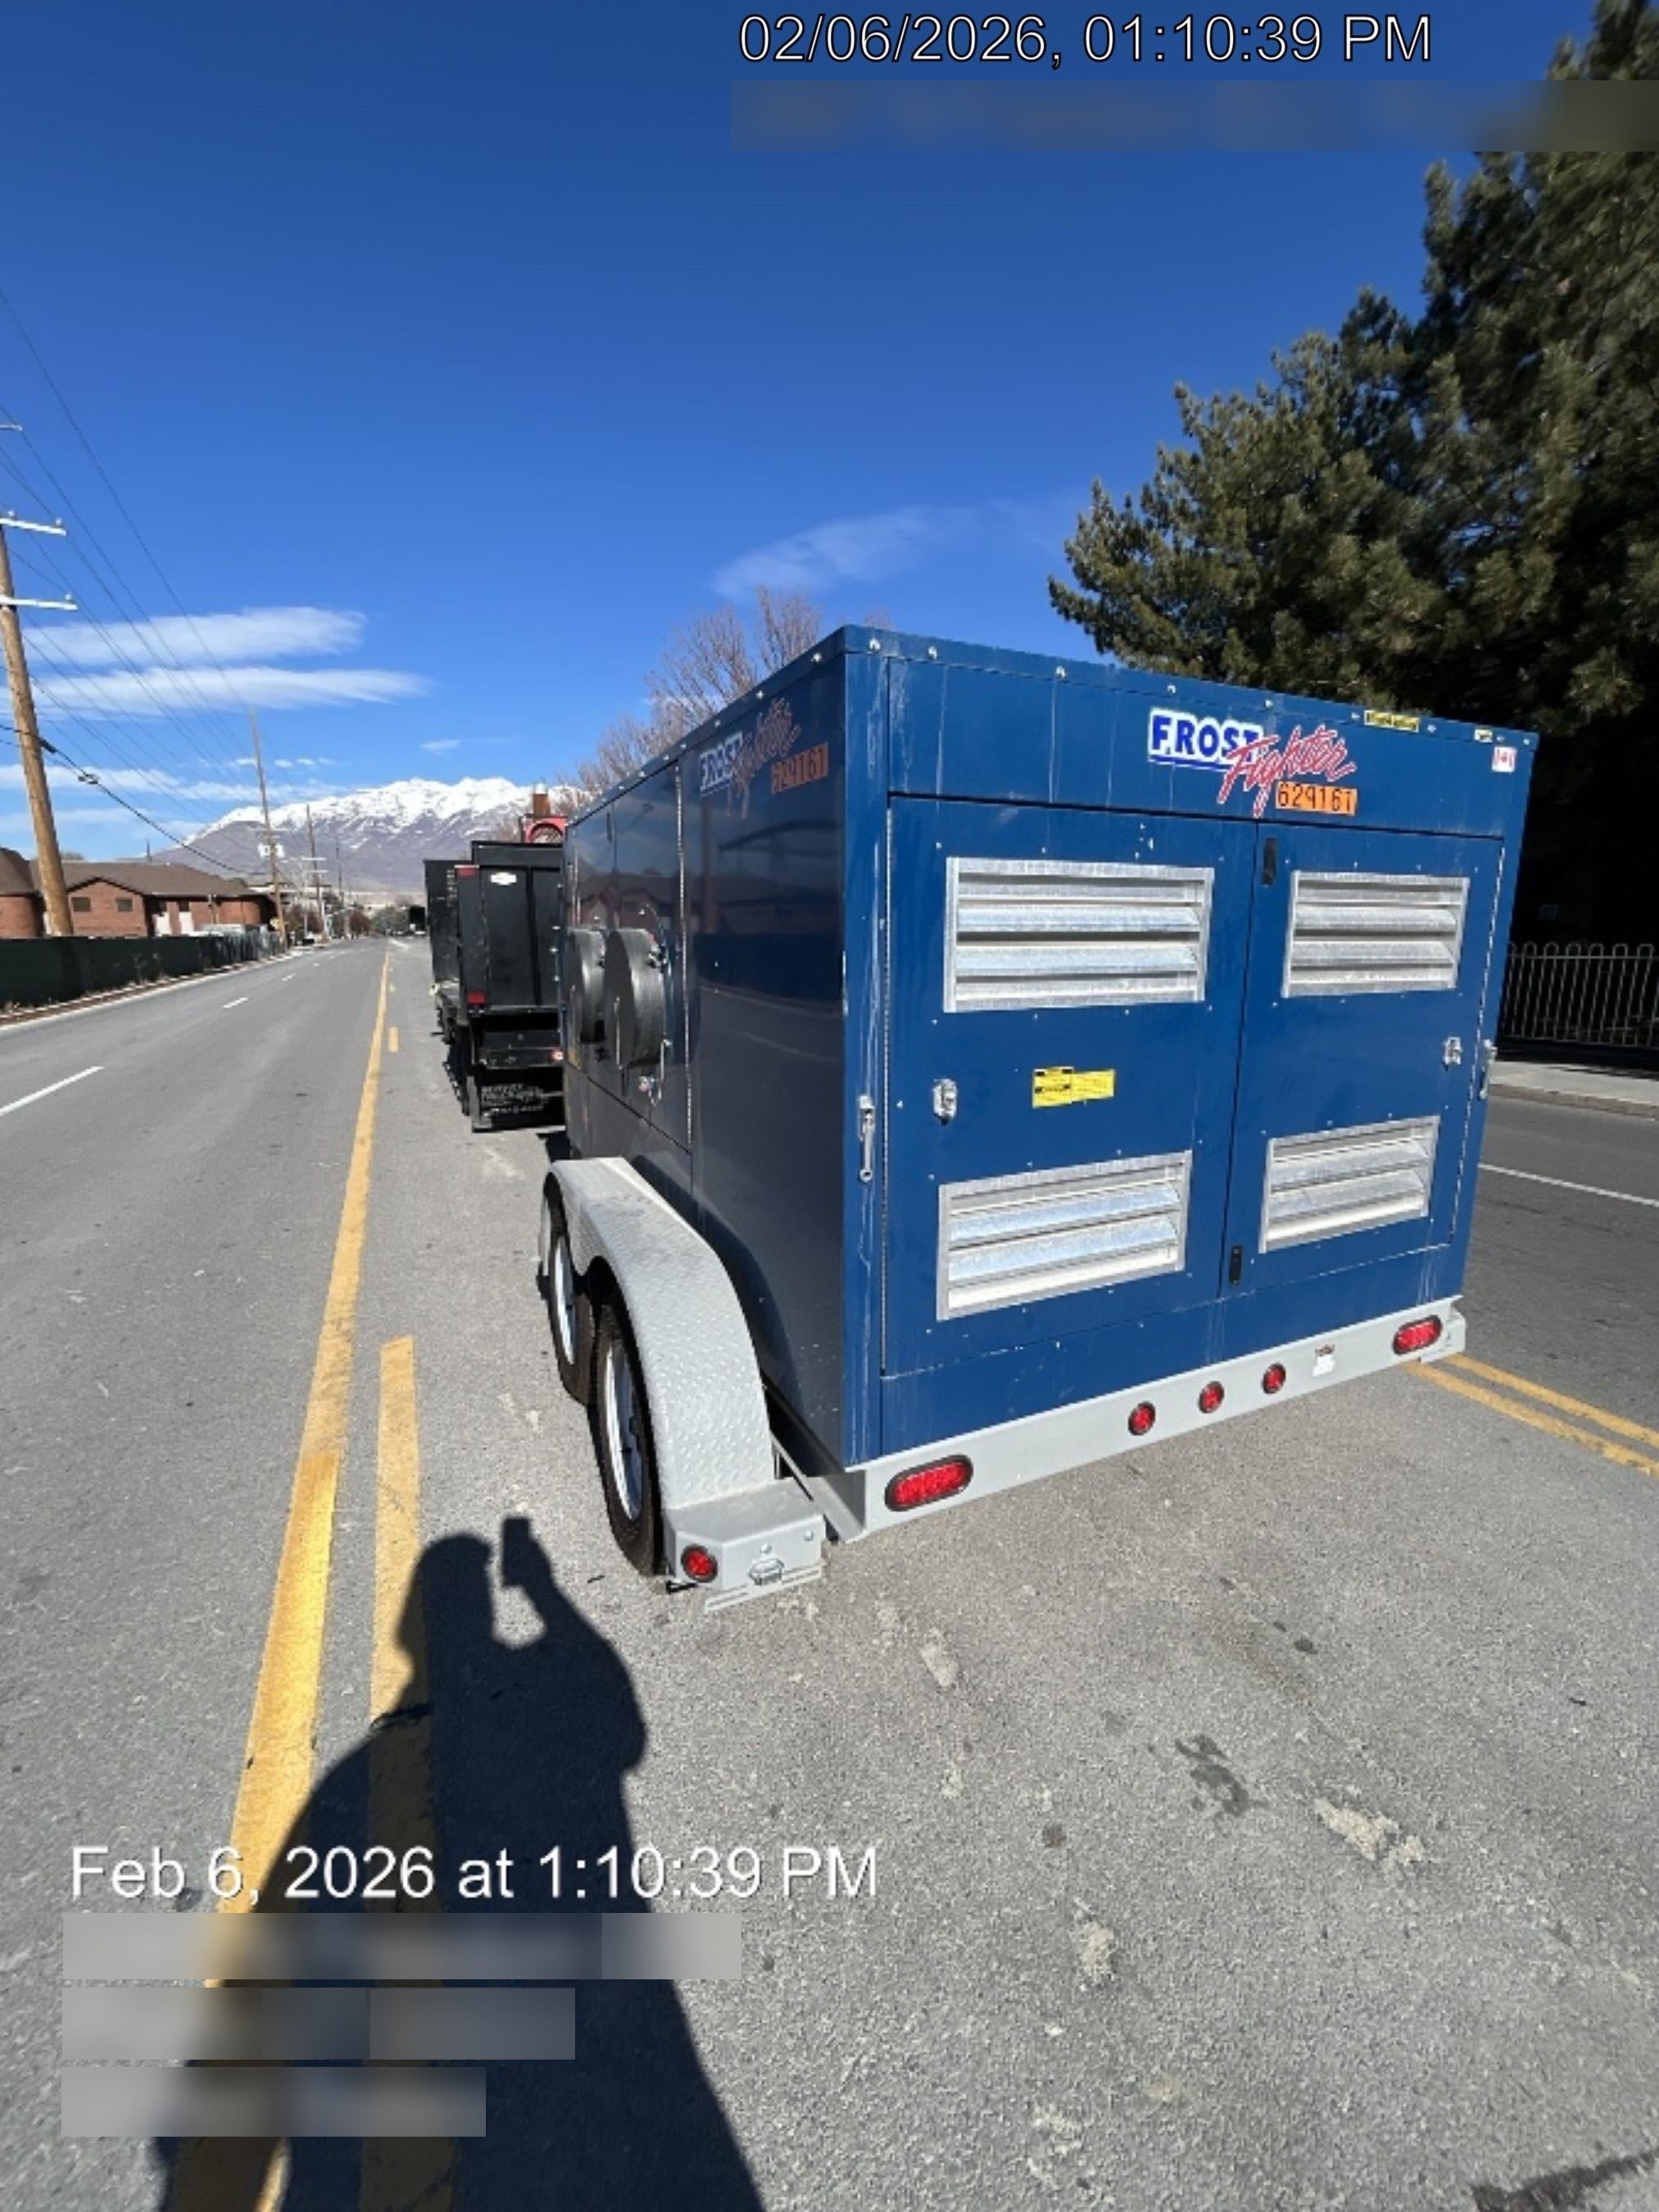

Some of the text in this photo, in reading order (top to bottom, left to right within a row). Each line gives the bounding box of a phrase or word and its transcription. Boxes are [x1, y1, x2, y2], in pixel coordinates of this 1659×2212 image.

[1149, 709, 1262, 764] FROST
[1217, 723, 1357, 818] Fighter
[1276, 781, 1353, 812] 629161
